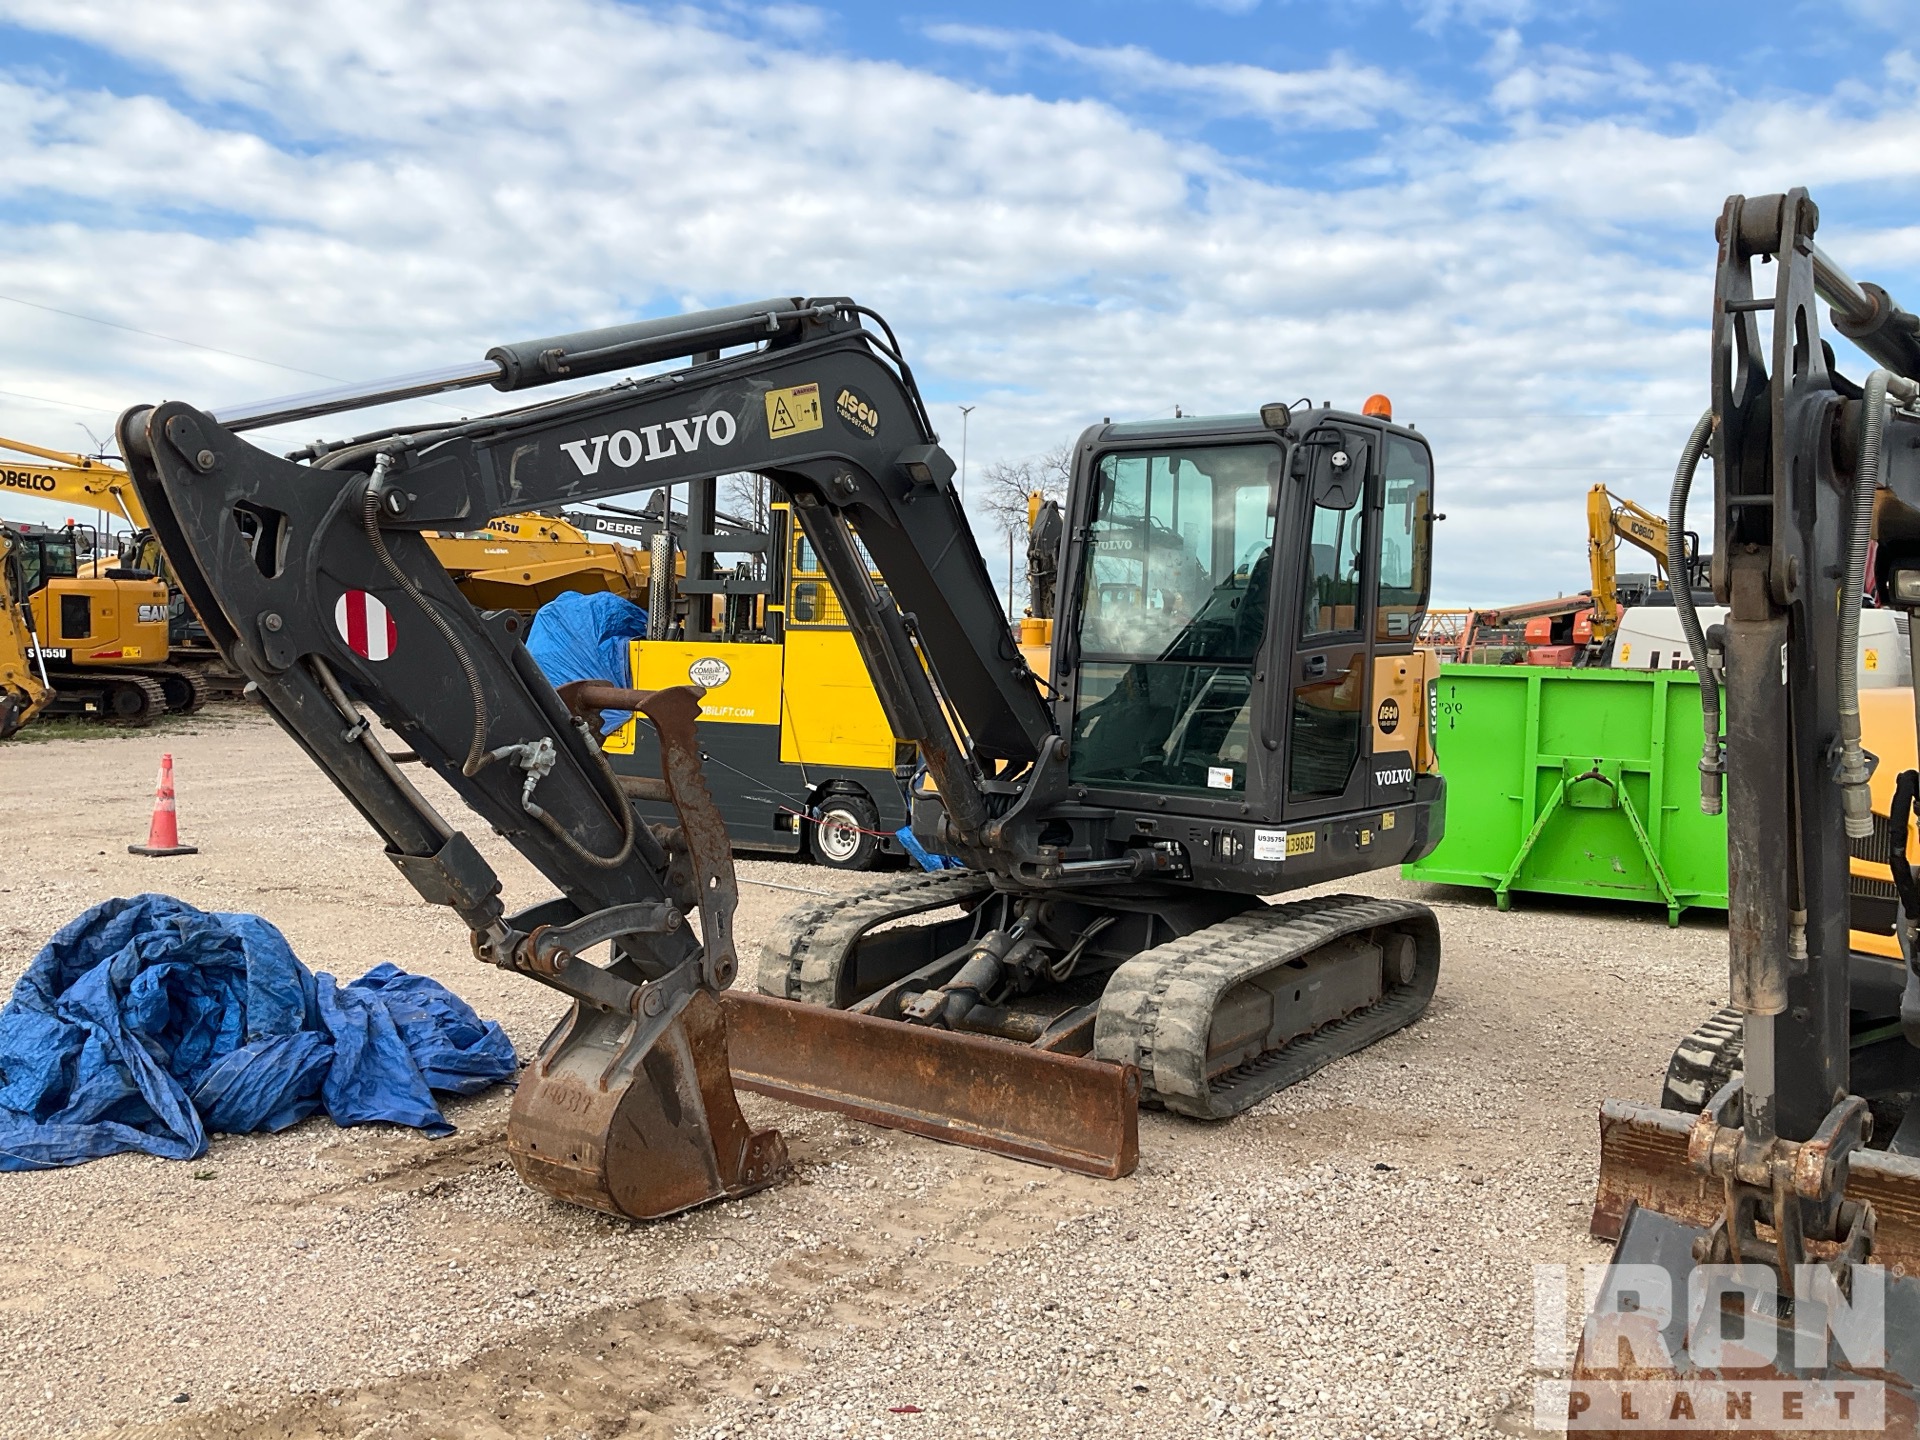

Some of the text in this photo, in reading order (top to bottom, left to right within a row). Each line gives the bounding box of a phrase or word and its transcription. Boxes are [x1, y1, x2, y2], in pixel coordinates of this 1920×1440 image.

[837, 389, 878, 428] ASCO
[560, 410, 737, 476] VOLVO
[595, 518, 643, 536] DEERE
[1631, 521, 1655, 541] KOBELCO
[27, 648, 67, 659] S155U
[1379, 706, 1398, 719] ASCO
[1375, 768, 1412, 786] VOLVO
